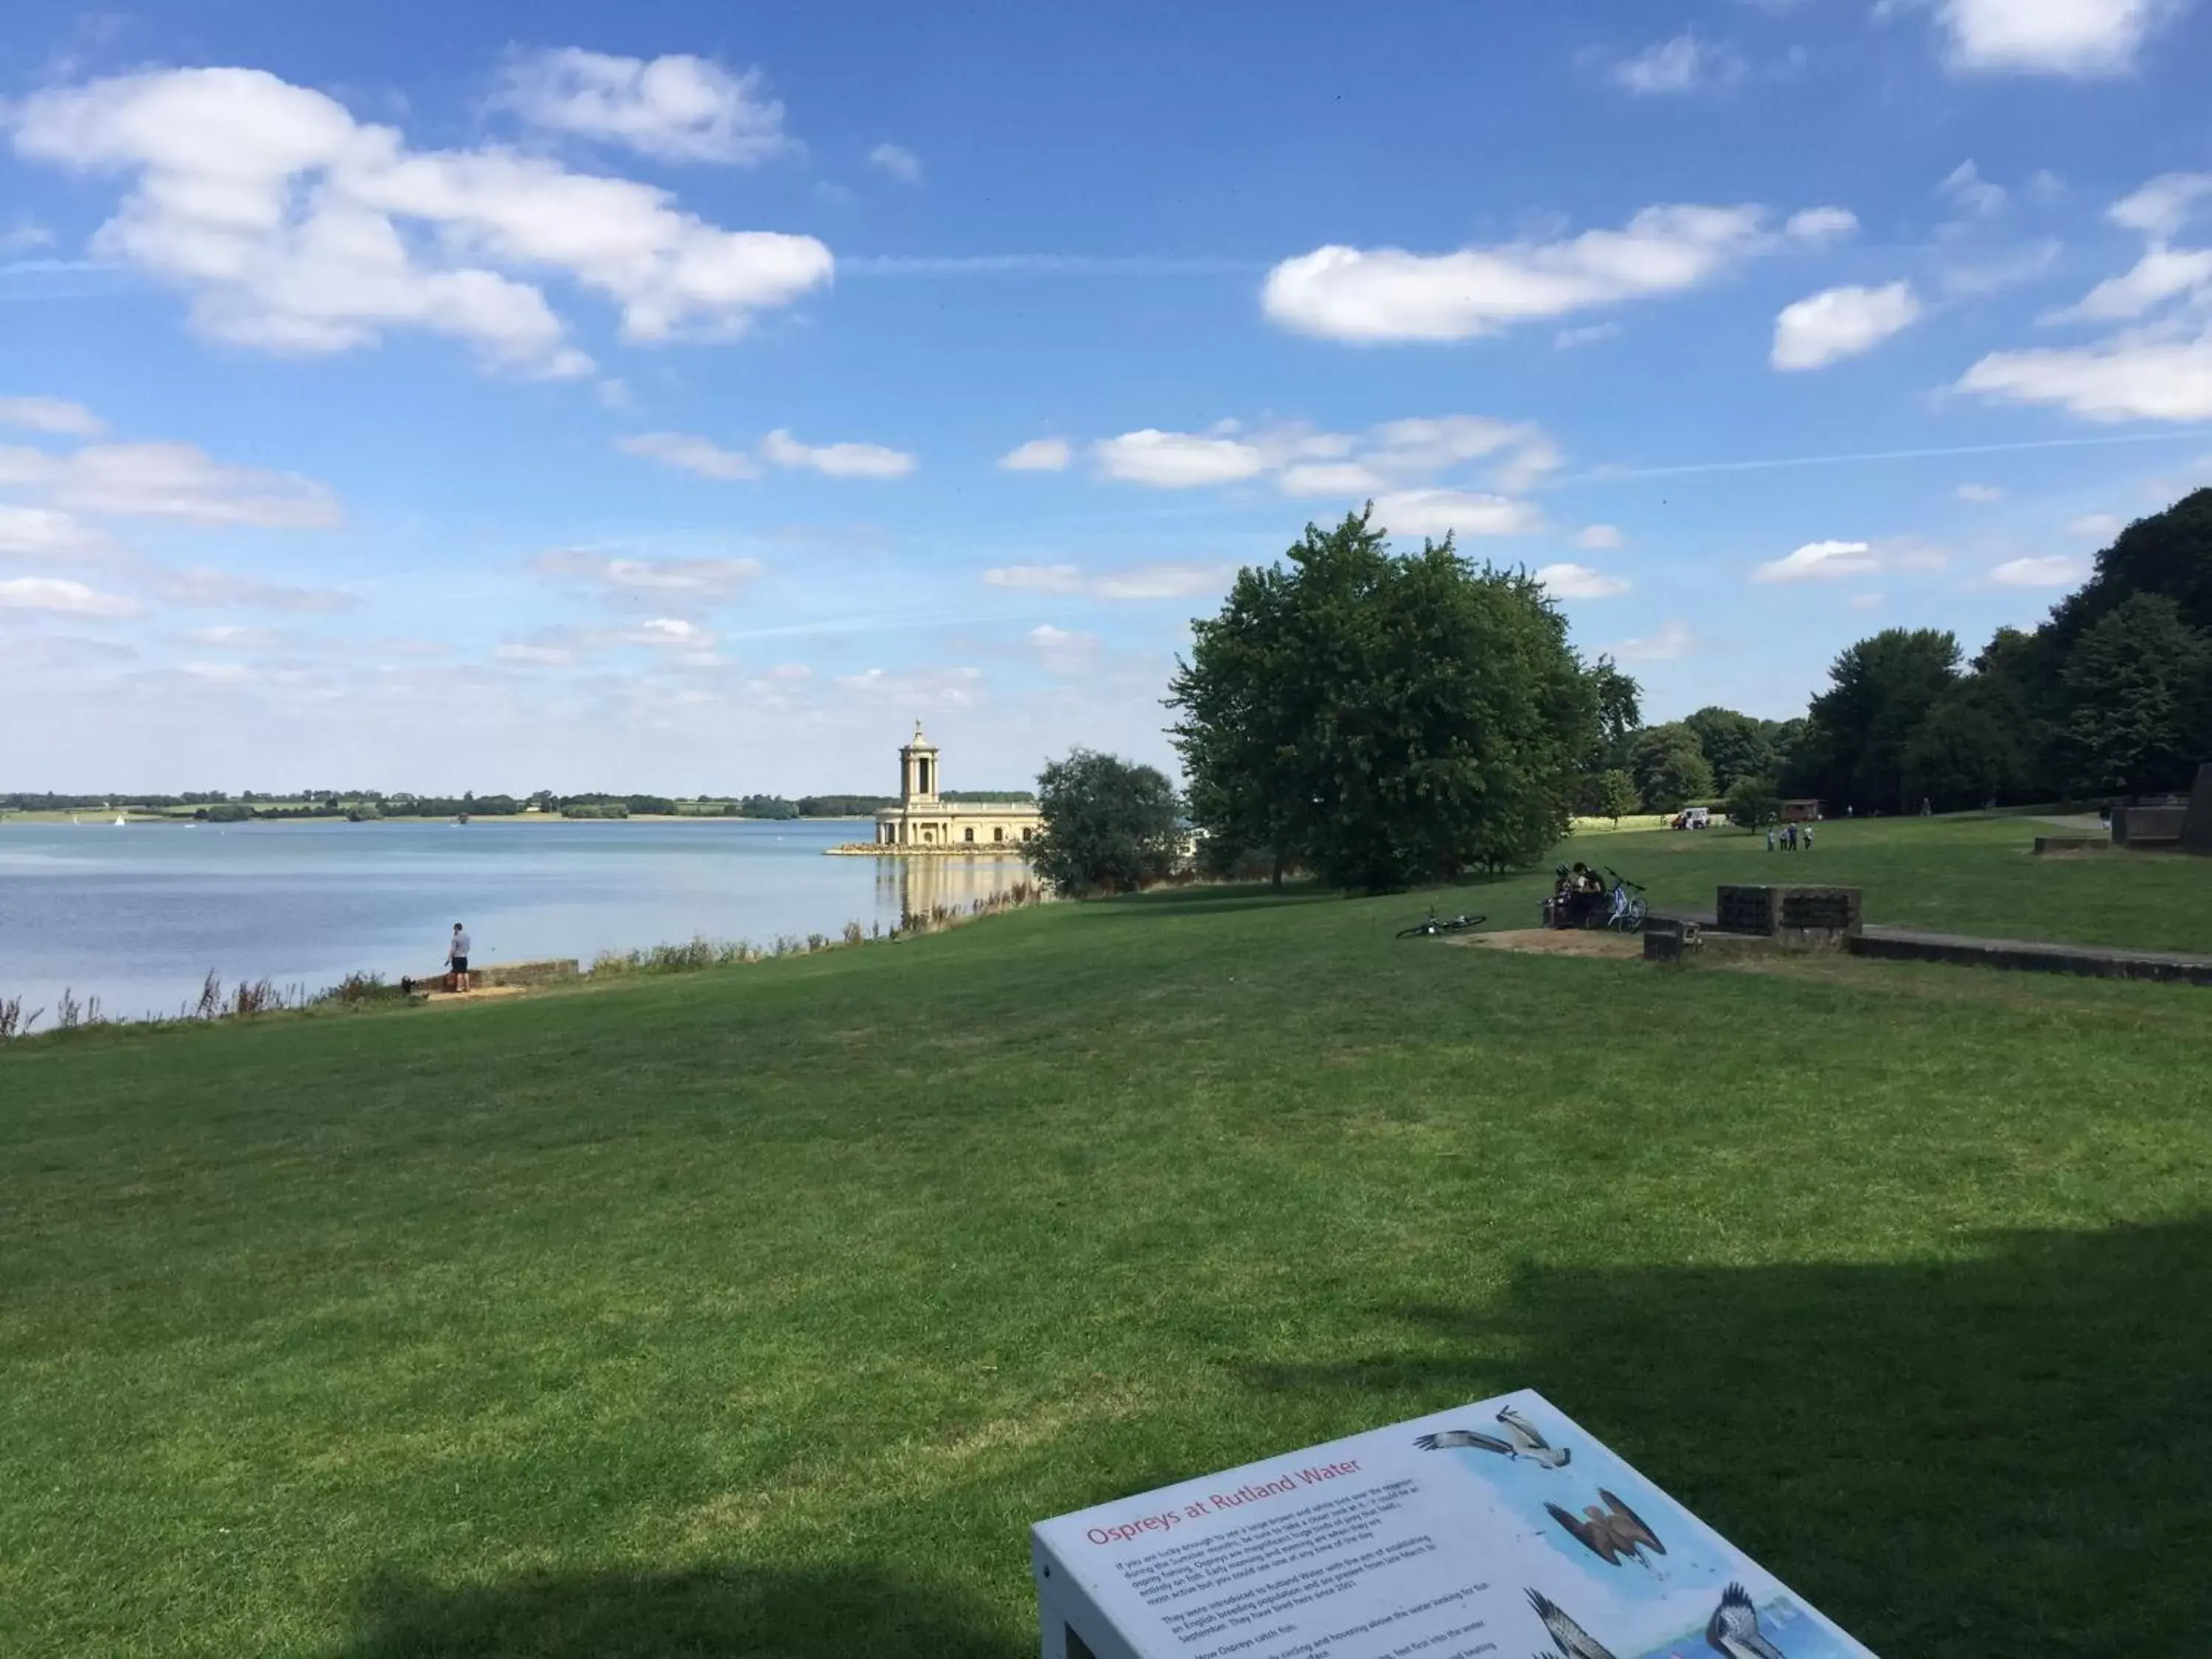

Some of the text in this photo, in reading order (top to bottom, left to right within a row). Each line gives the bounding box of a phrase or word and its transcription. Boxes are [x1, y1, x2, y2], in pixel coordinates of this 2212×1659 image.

[1087, 1460, 1360, 1545] Ospreys at Rutland Water
